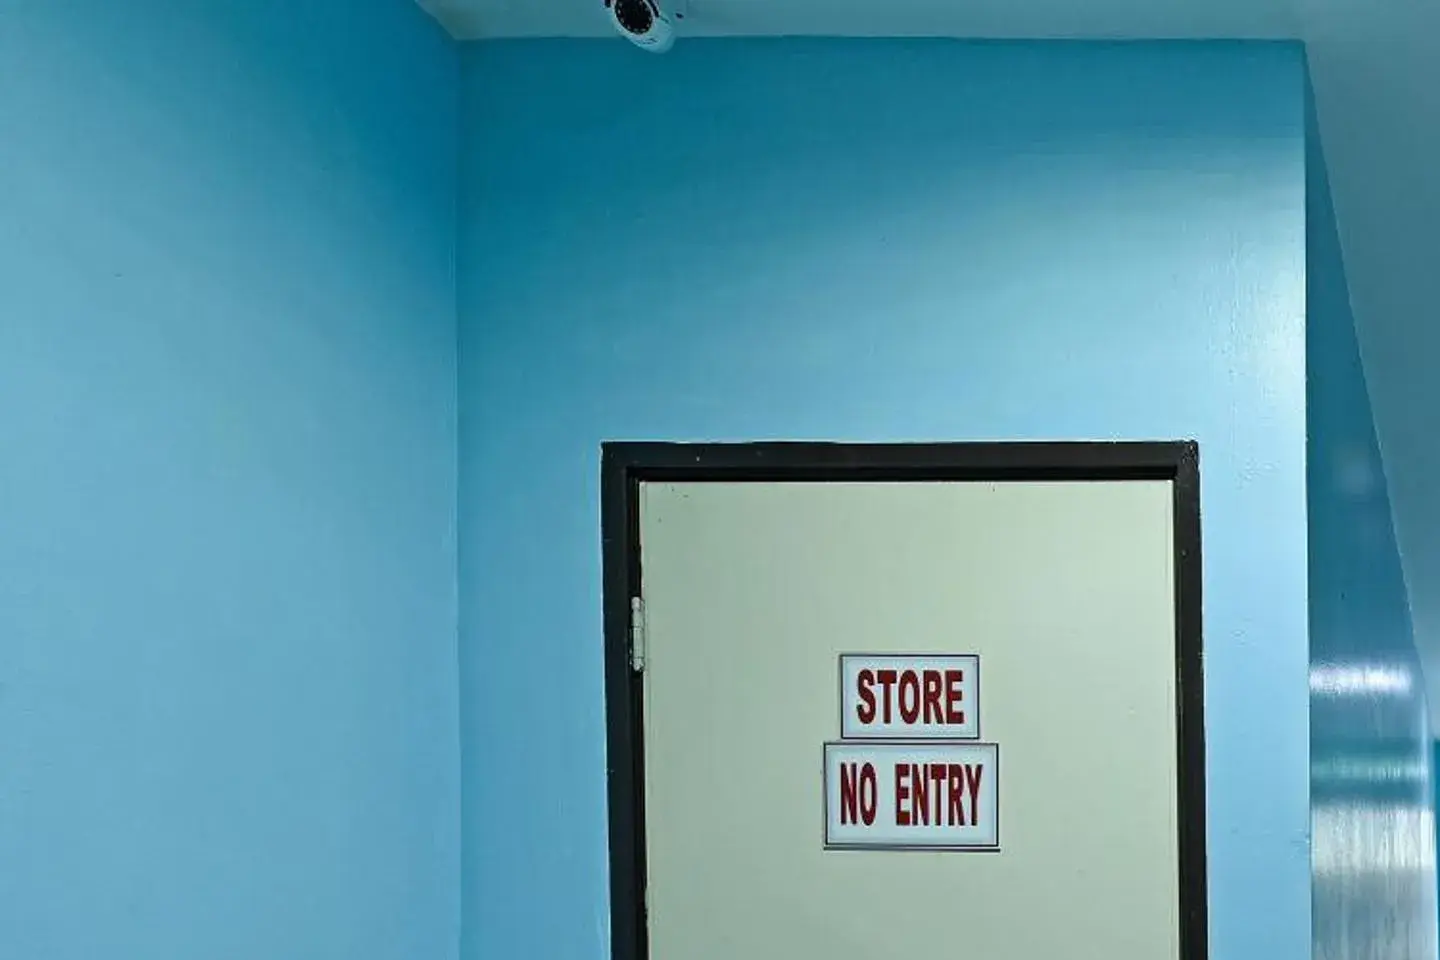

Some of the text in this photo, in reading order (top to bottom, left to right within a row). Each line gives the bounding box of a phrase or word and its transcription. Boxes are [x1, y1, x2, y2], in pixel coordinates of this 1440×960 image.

[856, 669, 965, 724] STORE
[840, 762, 983, 826] NO ENTRY
